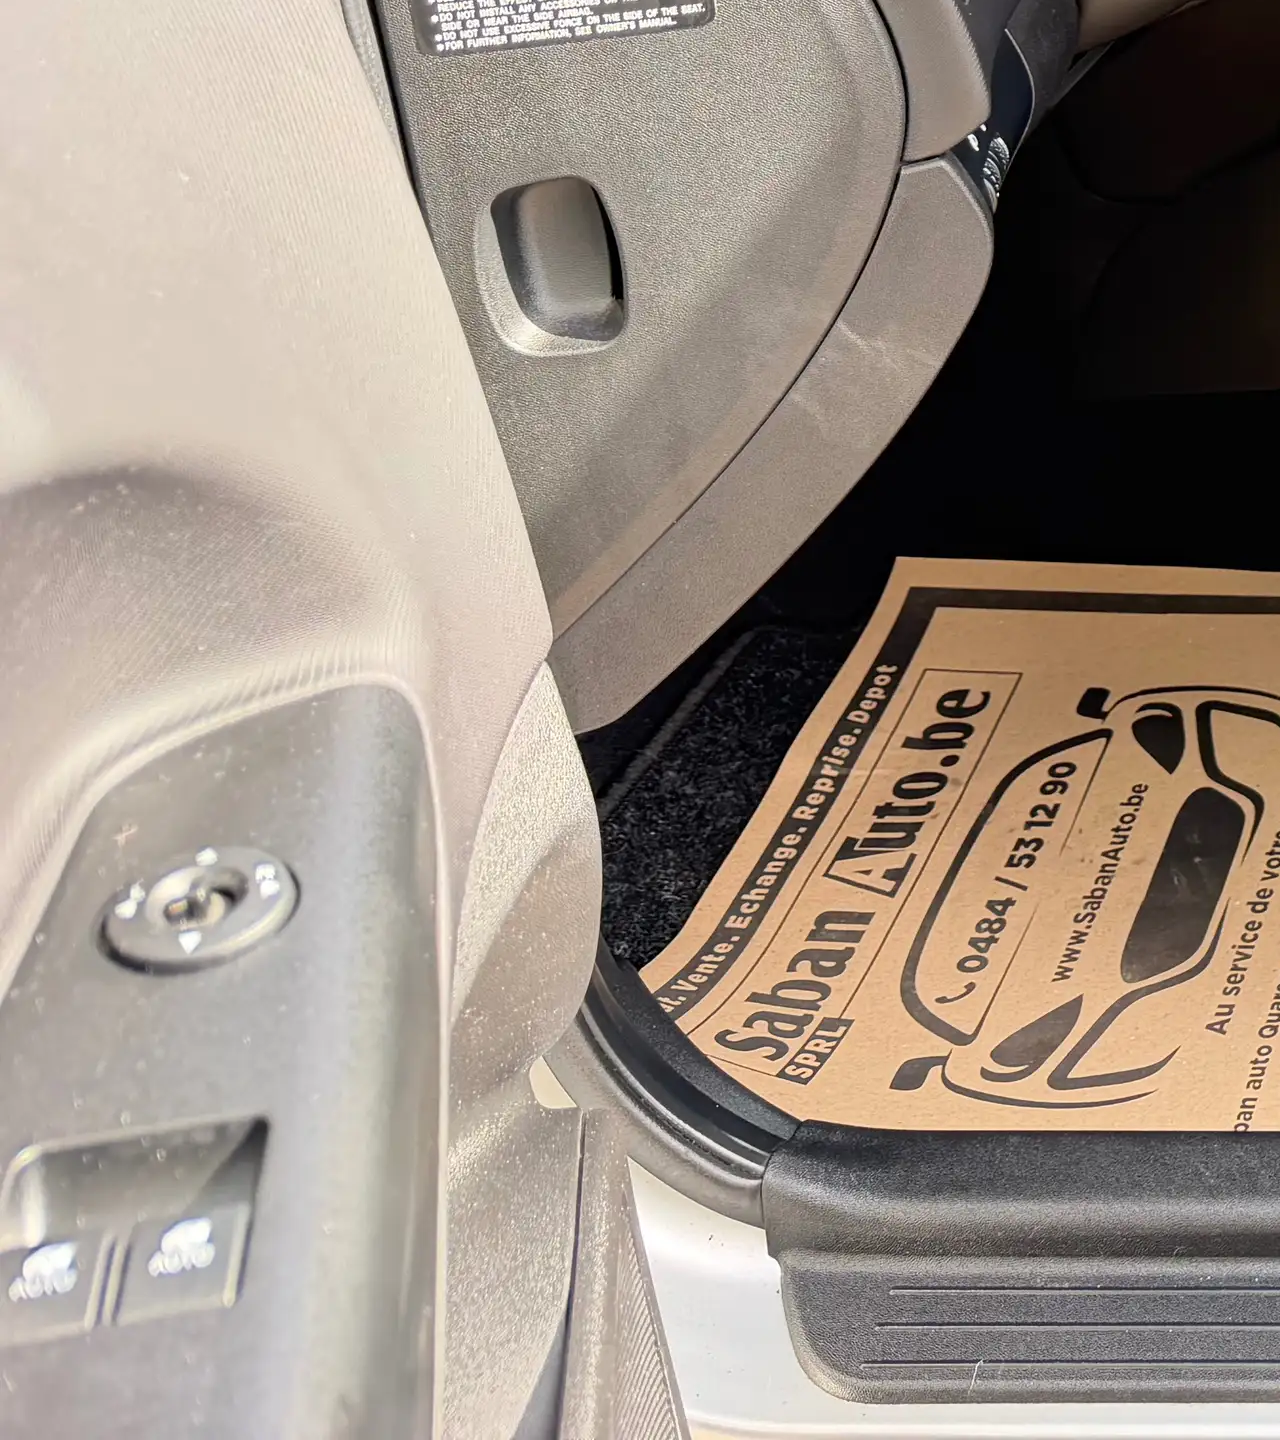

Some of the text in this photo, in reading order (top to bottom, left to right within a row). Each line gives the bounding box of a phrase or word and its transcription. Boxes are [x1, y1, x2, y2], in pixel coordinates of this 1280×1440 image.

[670, 936, 740, 992] Vente.
[725, 826, 806, 929] Echange.
[792, 728, 863, 821] Reprise.
[847, 664, 899, 723] Depot
[714, 688, 991, 1062] Saban Auto.be
[956, 761, 1077, 973] 0484 / 53 12 90
[1051, 783, 1149, 983] www.SabanAuto.be
[784, 1023, 850, 1080] SPRL
[1205, 1003, 1235, 1035] Au
[1222, 919, 1262, 996] service
[1247, 884, 1274, 913] de
[1246, 1044, 1273, 1091] auto
